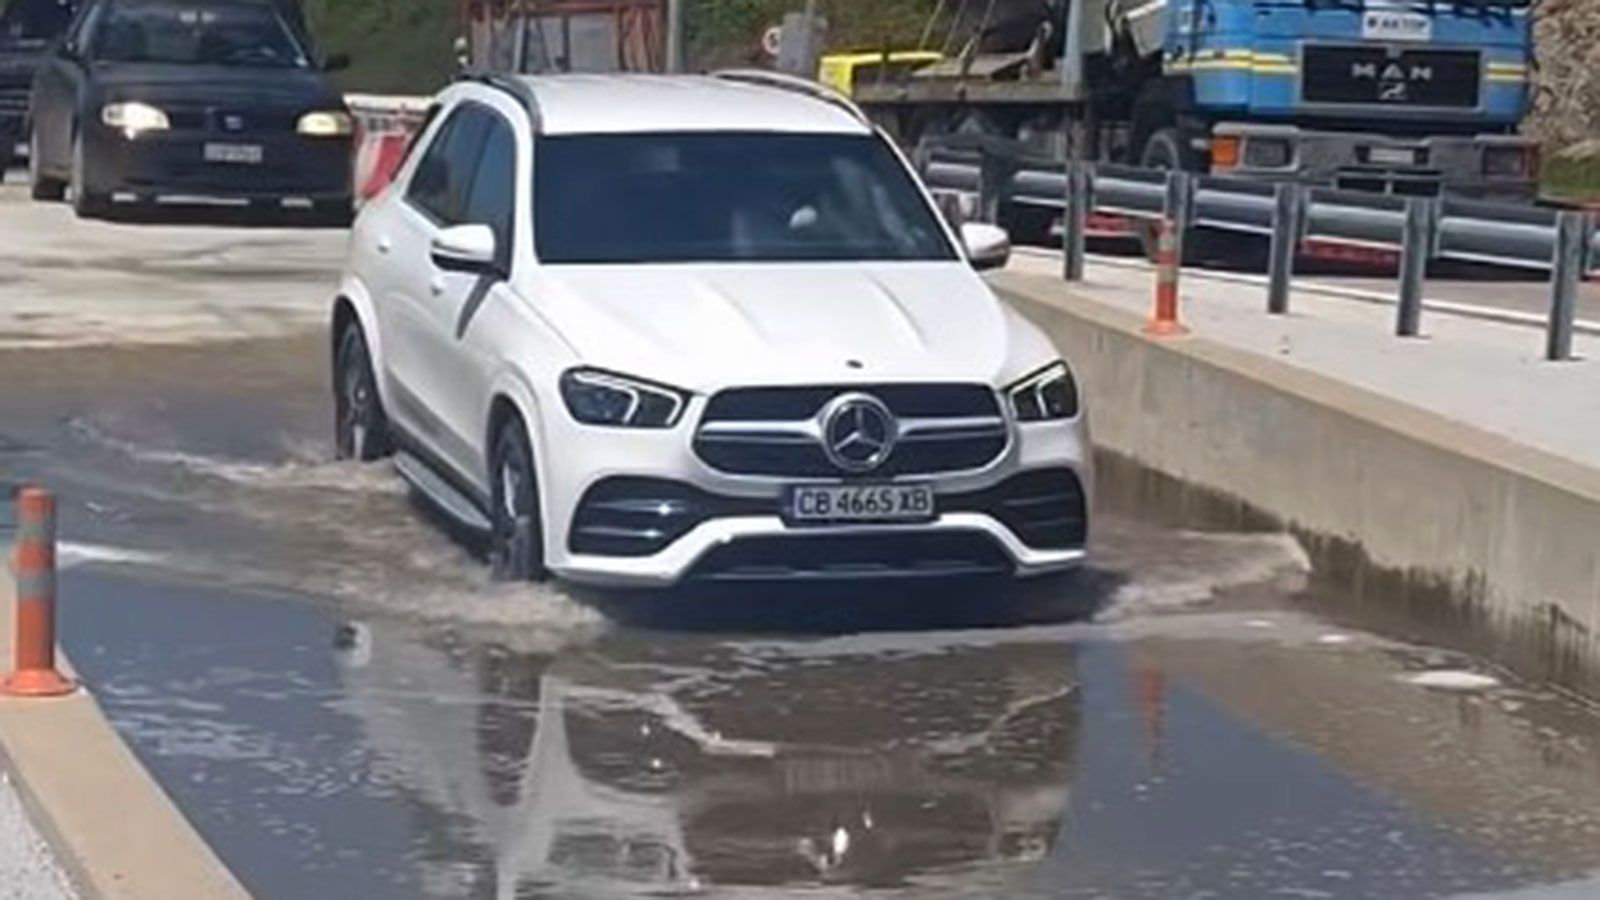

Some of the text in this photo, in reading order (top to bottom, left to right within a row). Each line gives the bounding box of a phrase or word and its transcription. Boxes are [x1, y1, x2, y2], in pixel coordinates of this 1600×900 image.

[1352, 63, 1432, 80] MAN
[800, 492, 831, 515] CB
[837, 490, 893, 514] 4665
